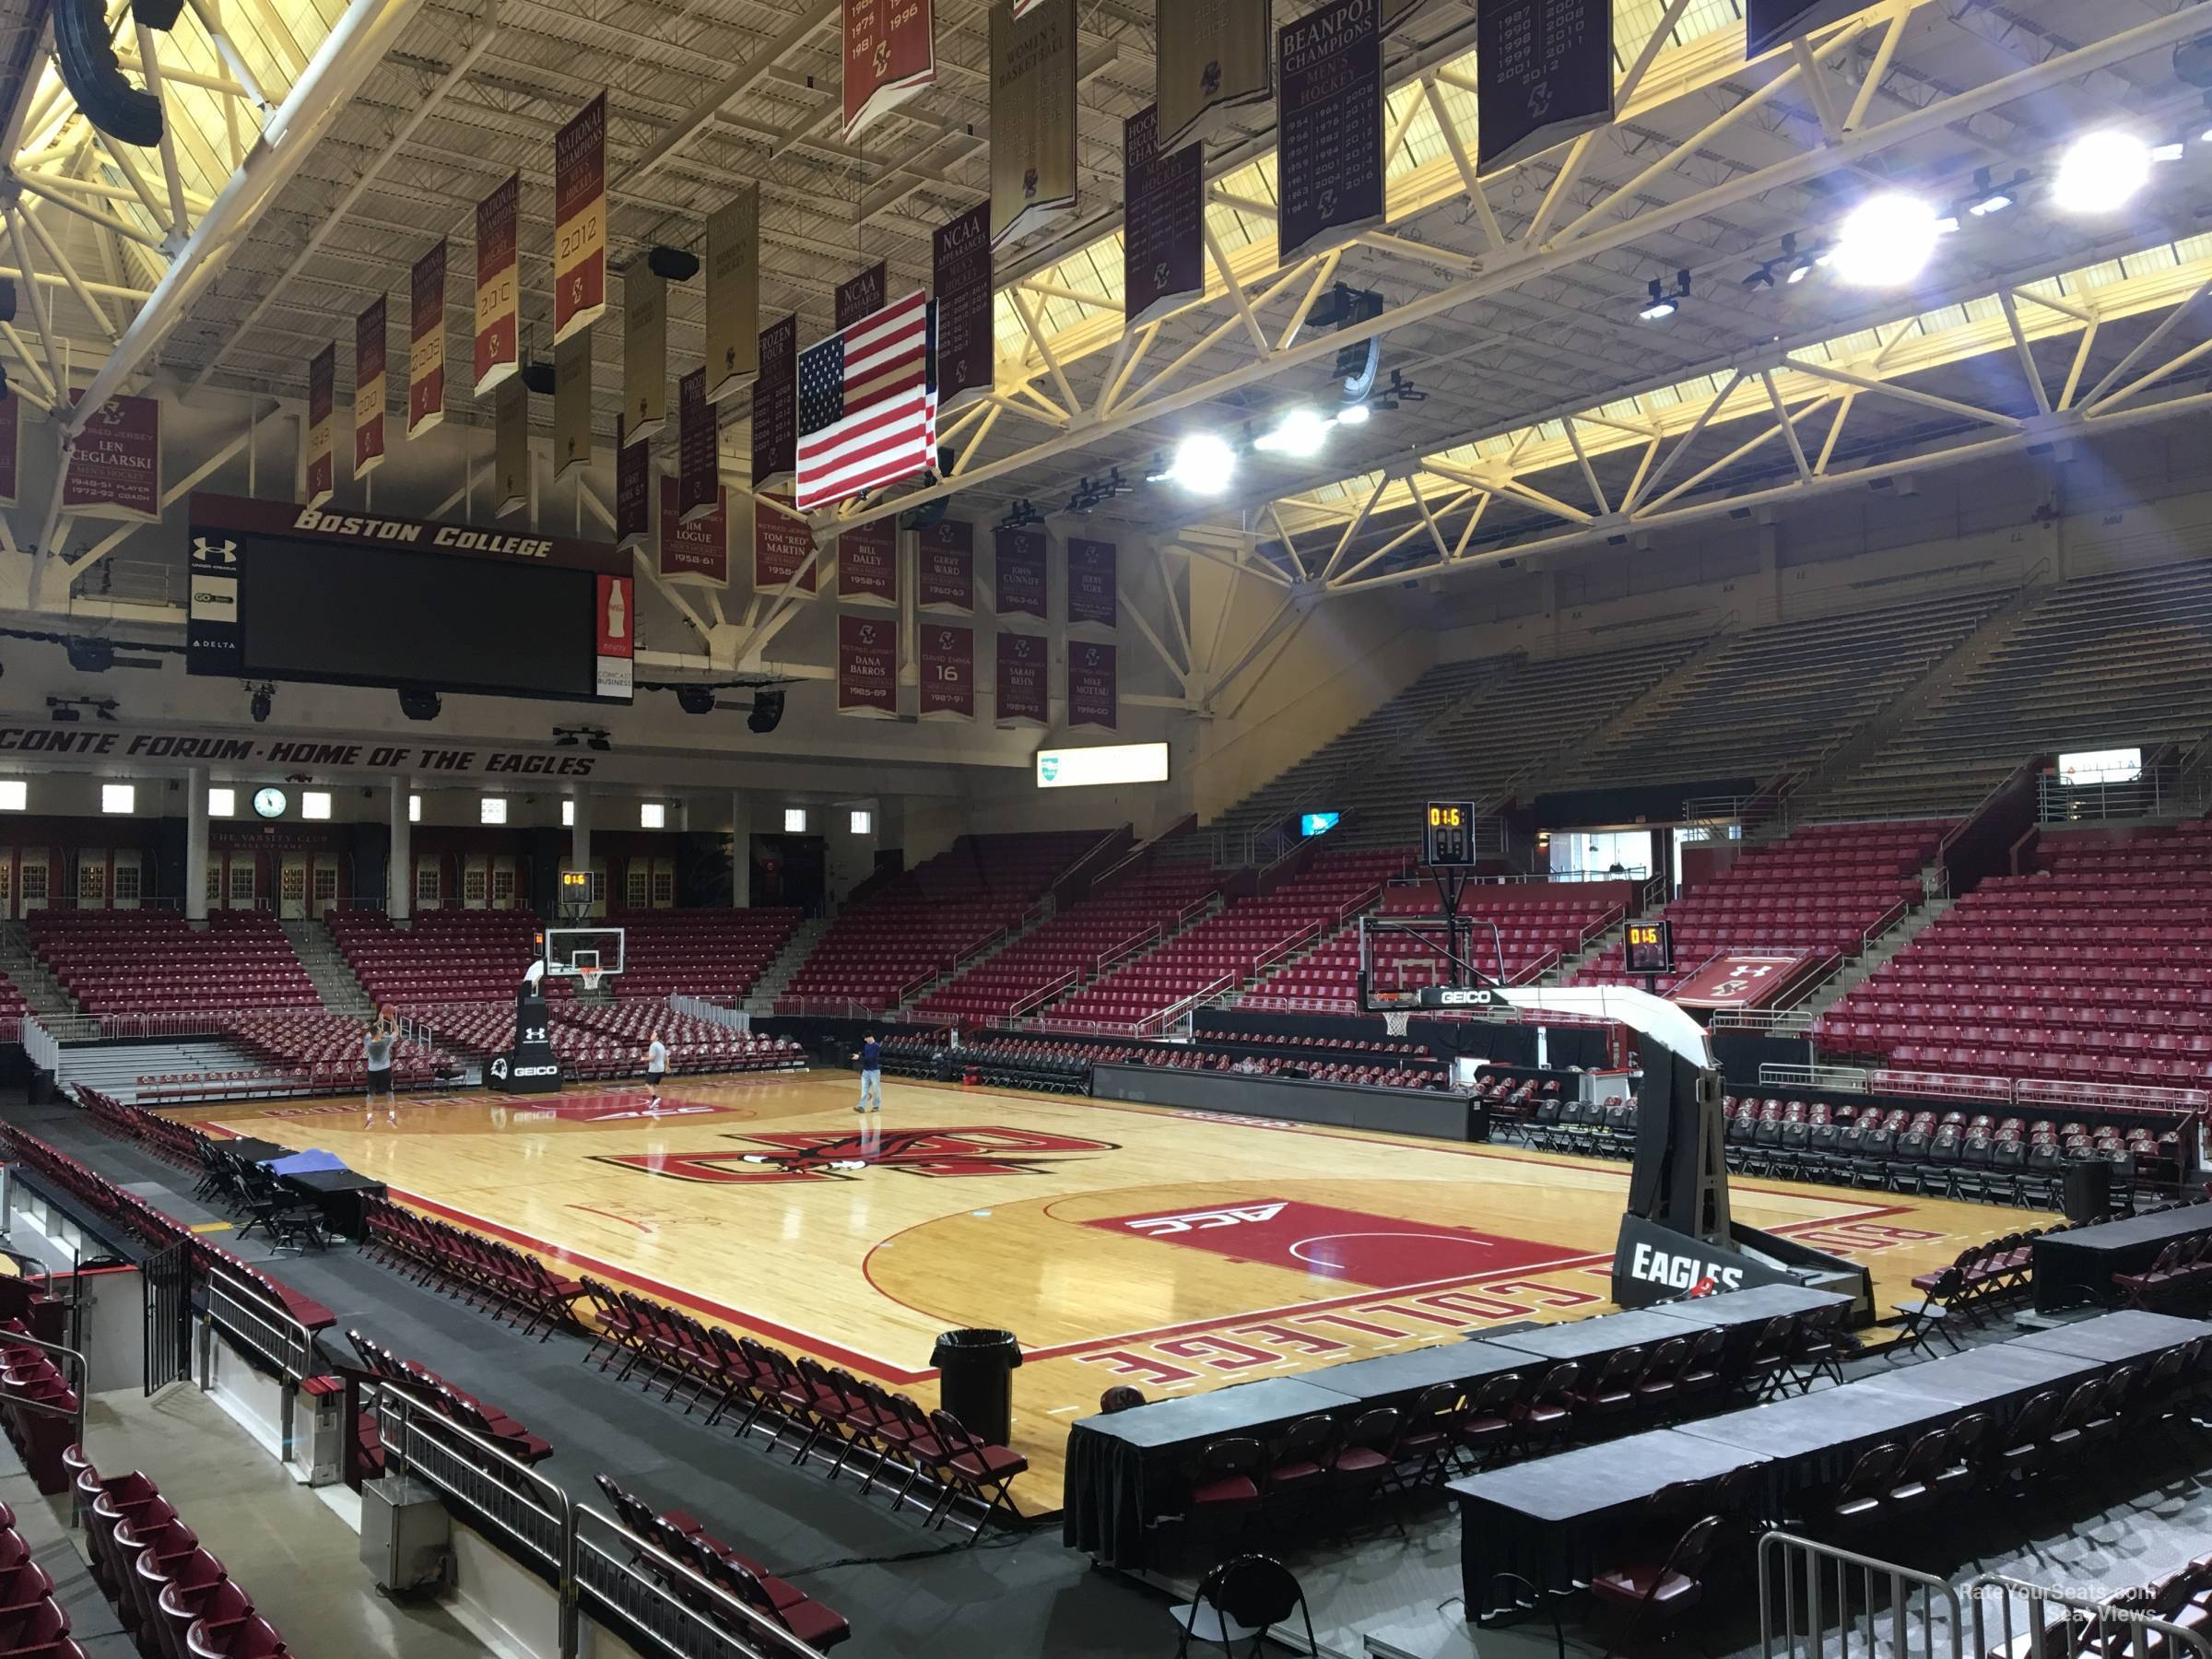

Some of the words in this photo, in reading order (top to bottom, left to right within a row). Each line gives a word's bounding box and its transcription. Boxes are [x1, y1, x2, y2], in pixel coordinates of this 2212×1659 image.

[890, 3, 918, 31] 1996
[1499, 6, 1530, 29] 1987
[1547, 6, 1584, 31] 2008
[1499, 19, 1530, 43] 1990
[1547, 20, 1584, 45] 2010
[852, 35, 873, 59] 1981
[1286, 15, 1371, 72] CHAMPIONS
[1547, 35, 1583, 58] 2011
[999, 36, 1063, 88] BASKETBALL
[1497, 59, 1530, 83] 2001
[1523, 59, 1559, 85] 2012
[1300, 67, 1356, 104] HOCKEY
[558, 108, 602, 159] NATIONAL
[1129, 111, 1158, 139] HOCK
[558, 125, 603, 173] CHAMPIONS
[1128, 127, 1159, 154] REGULA
[560, 217, 596, 260] 2012
[943, 215, 980, 253] NCAA
[937, 232, 987, 266] APPEARANCES
[844, 276, 875, 305] NCAA
[762, 345, 783, 363] FOUR
[114, 431, 155, 441] JERSEY
[100, 441, 124, 453] LEN
[72, 449, 151, 469] CEGLARSKI
[73, 487, 114, 497] 1972-92
[118, 493, 149, 501] COACH
[117, 484, 149, 492] PLAYER
[293, 509, 422, 542] BOSTON
[433, 526, 552, 558] COLLEGE
[677, 531, 712, 543] LOGUE
[763, 533, 782, 543] TOM
[767, 543, 805, 556] MARTIN
[859, 546, 876, 554] BILL
[675, 554, 713, 565] 1958-61
[853, 554, 882, 566] DALEY
[934, 555, 959, 565] GERRY
[769, 566, 795, 575] 1958-
[934, 565, 960, 576] WARD
[851, 576, 886, 586] 1958-61
[203, 641, 235, 649] DELTA
[855, 655, 881, 665] DANA
[923, 653, 946, 663] DAVID
[597, 671, 631, 679] COMCAST
[850, 665, 886, 676] BARROS
[935, 665, 959, 681] 16
[1009, 667, 1035, 677] SARAH
[597, 678, 632, 687] BUSINESS
[1083, 677, 1101, 686] MIKE
[0, 729, 119, 754] CONTE
[126, 736, 253, 760] FORUM
[267, 741, 362, 765] HOME
[367, 747, 411, 768] OF
[418, 749, 476, 771] THE
[485, 753, 595, 776] EAGLES
[241, 833, 292, 842] VARSITY
[1441, 991, 1490, 1004] GEICO
[514, 1065, 558, 1077] GEICO
[1125, 1202, 1289, 1236] ACC
[1631, 1242, 1744, 1291] EAGLES
[1071, 1280, 1606, 1385] COLLEGE
